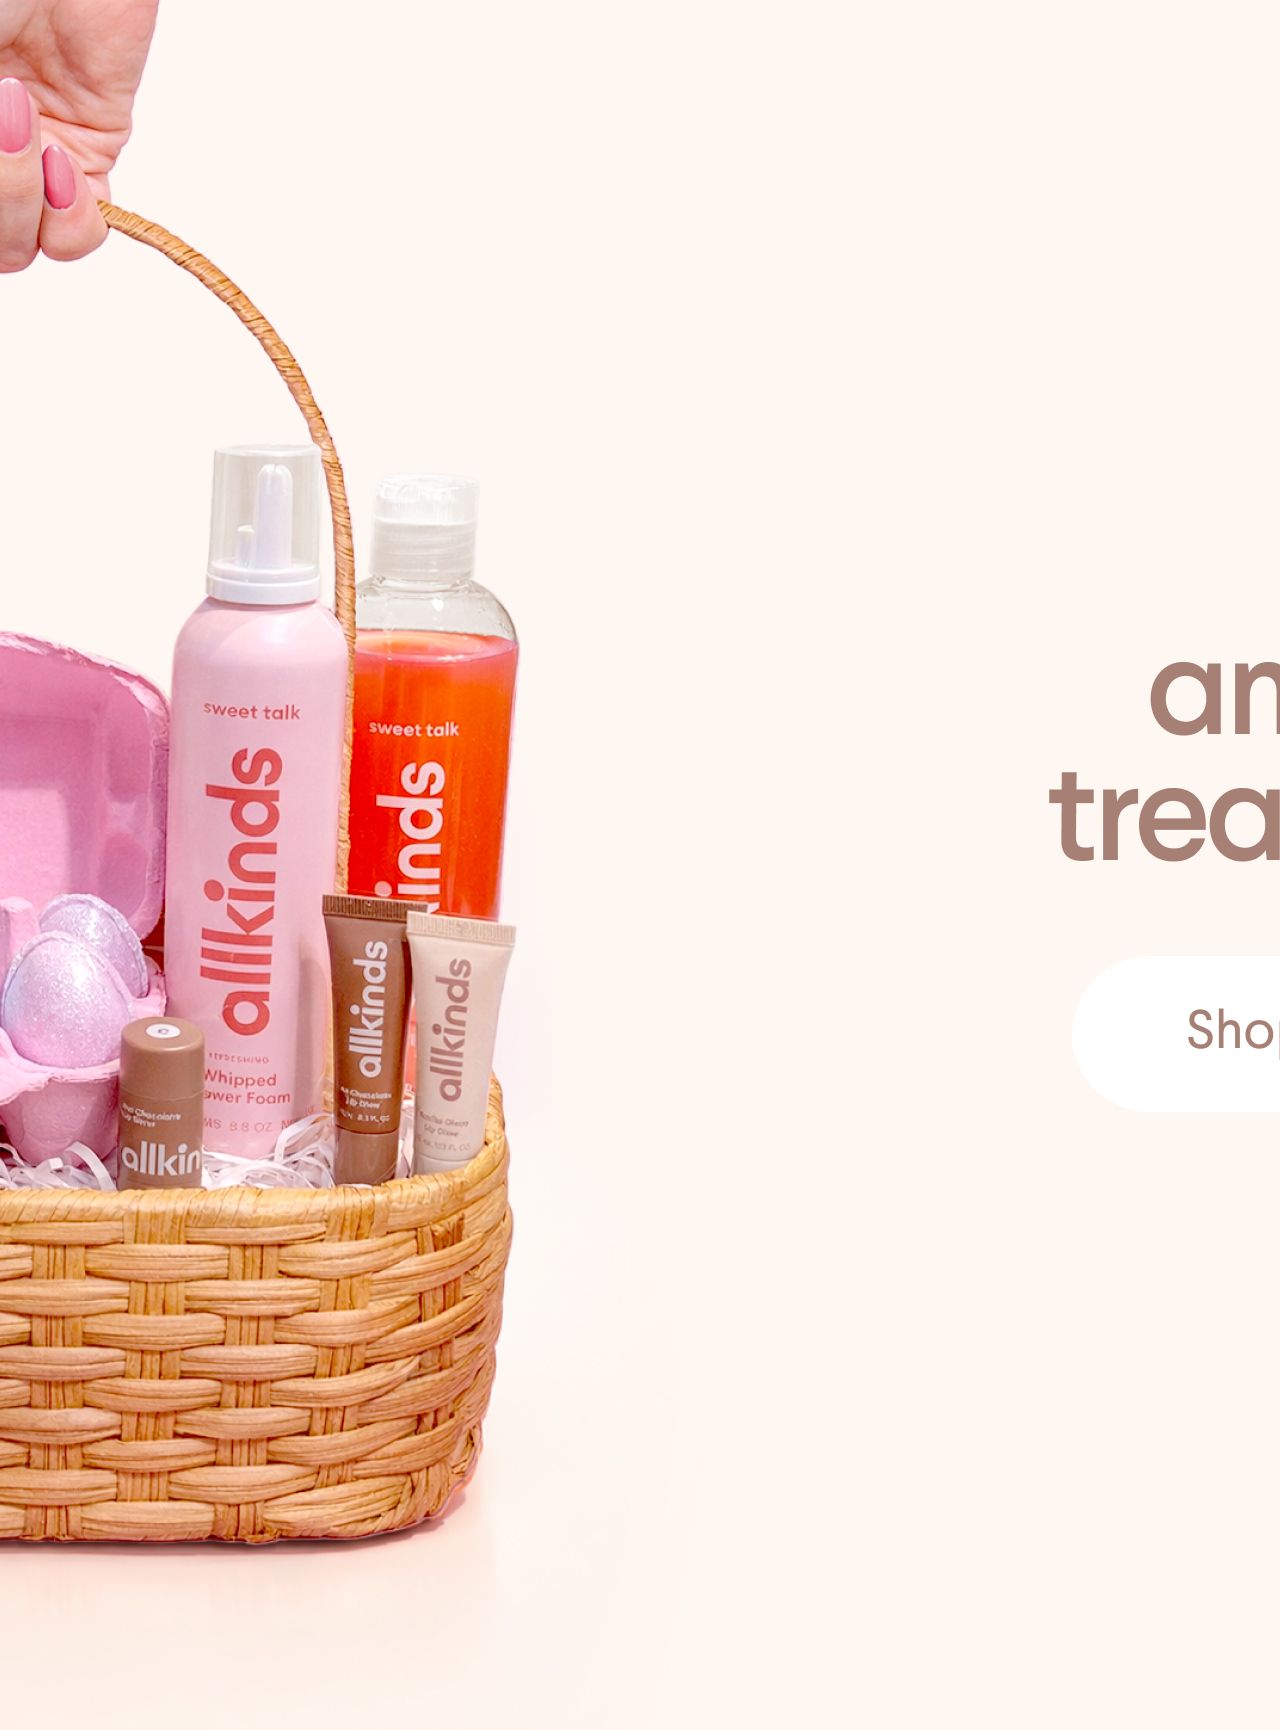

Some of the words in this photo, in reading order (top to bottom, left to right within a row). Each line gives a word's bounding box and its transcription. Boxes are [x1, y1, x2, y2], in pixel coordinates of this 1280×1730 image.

[204, 702, 258, 719] sweet
[263, 704, 301, 720] talk
[369, 722, 421, 737] sweet
[426, 721, 460, 737] talk
[200, 747, 283, 1036] allkinds
[374, 761, 445, 914] inds
[349, 940, 388, 1078] allkinds
[430, 958, 472, 1102] allkinds
[247, 1091, 291, 1105] Foam
